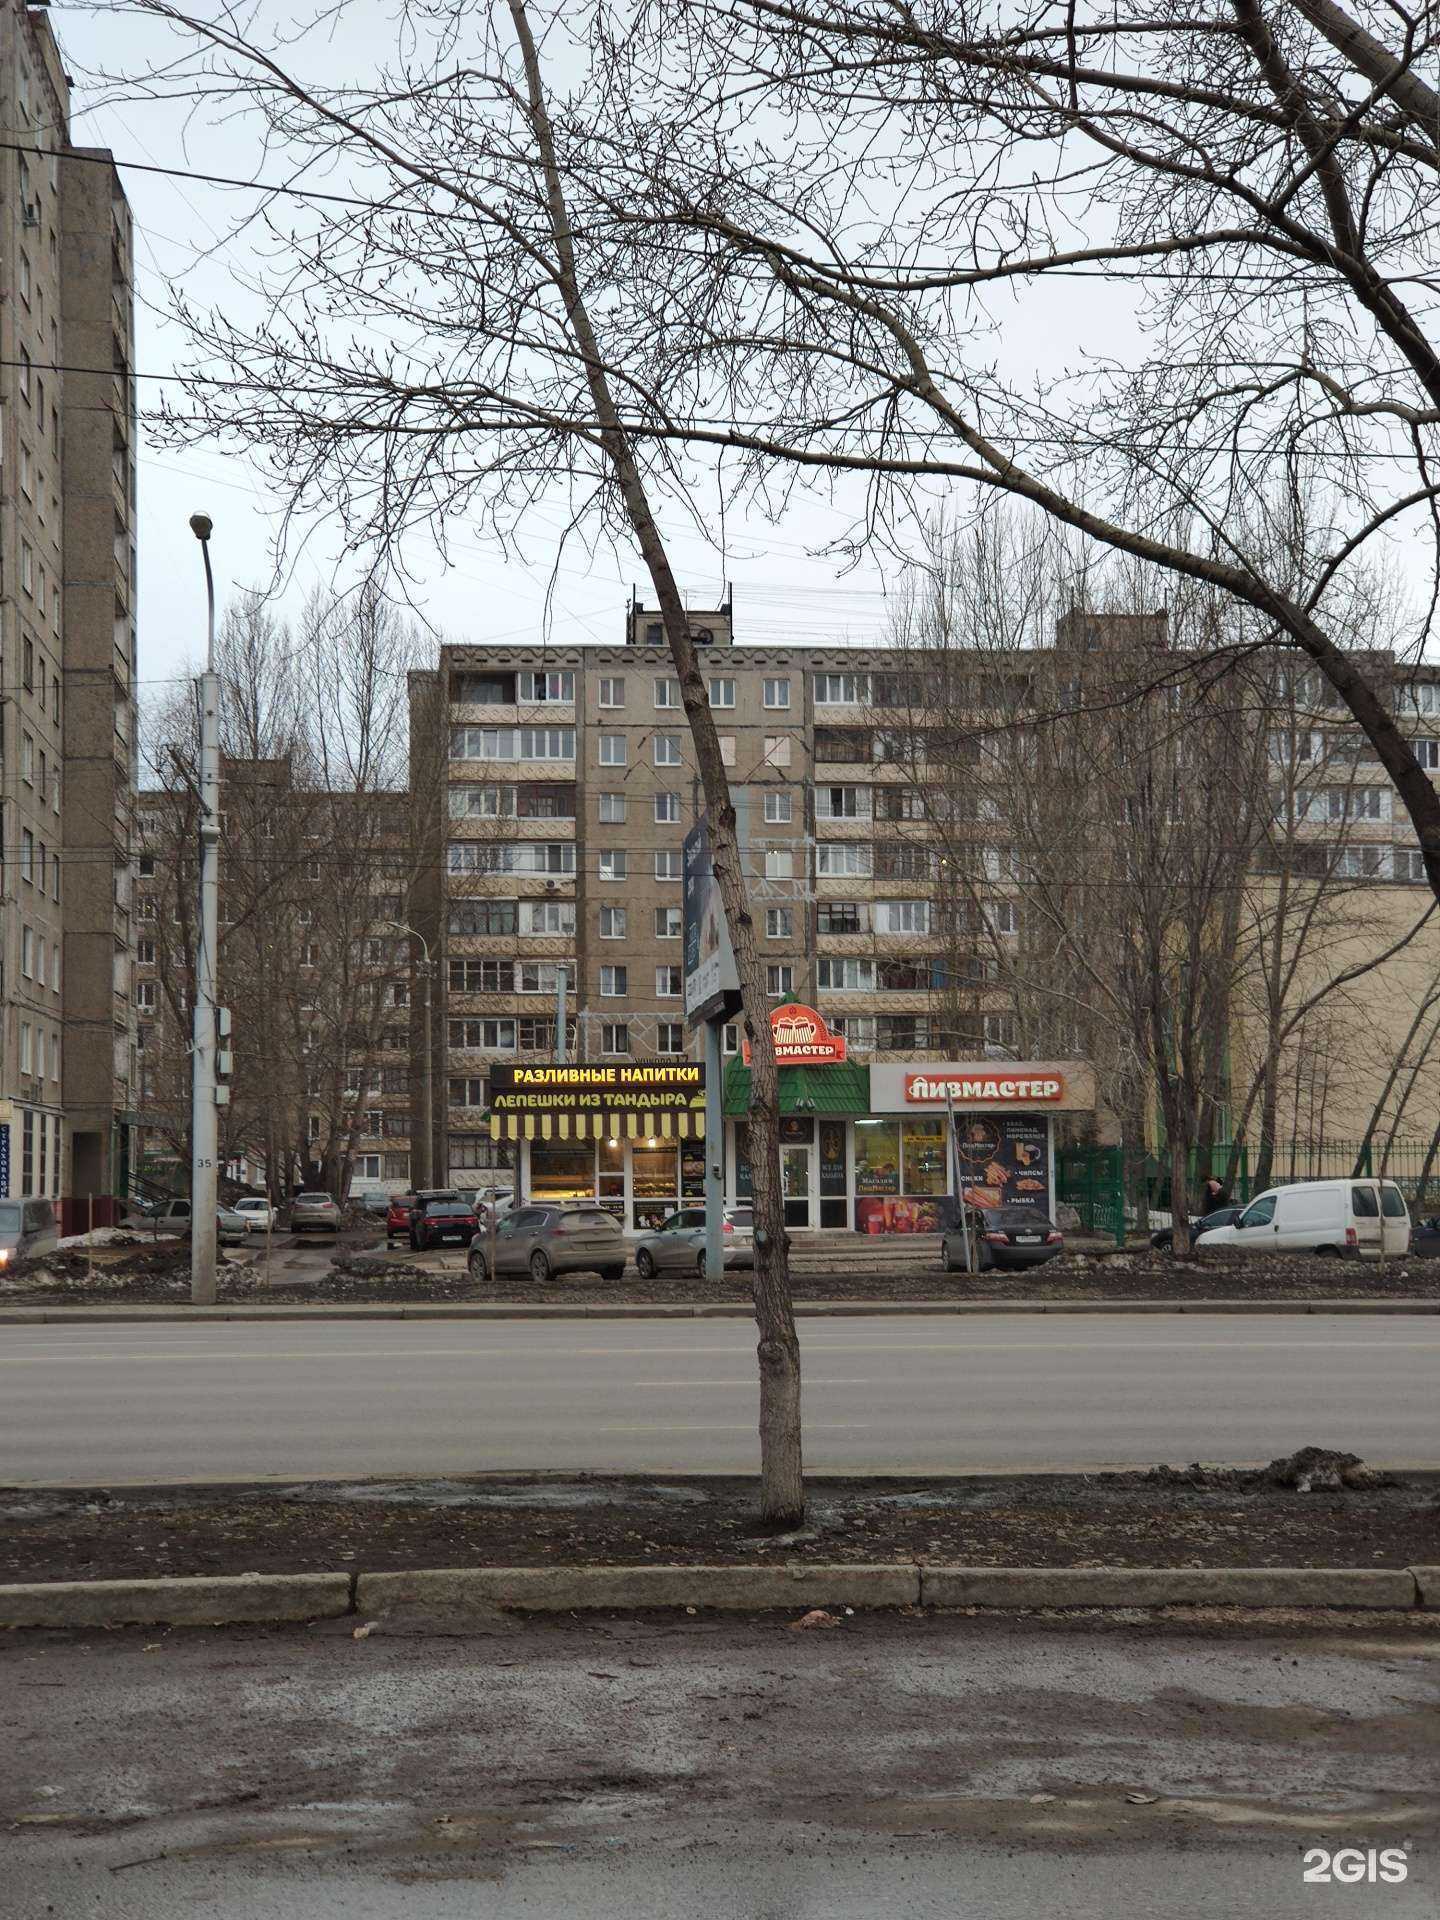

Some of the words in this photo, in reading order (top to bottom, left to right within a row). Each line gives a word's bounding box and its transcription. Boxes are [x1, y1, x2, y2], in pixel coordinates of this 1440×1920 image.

[774, 1045, 834, 1056] ВМАСТЕР
[513, 1069, 616, 1083] РАЗЛИВНЫЕ
[621, 1067, 699, 1081] НАПИТКИ
[909, 1077, 1060, 1098] ПИВМАСТЕР
[494, 1094, 577, 1108] ЛЕПЕШКИ
[579, 1095, 600, 1107] ИЗ
[603, 1093, 687, 1108] ТАНДЫРА
[197, 1159, 211, 1168] 35
